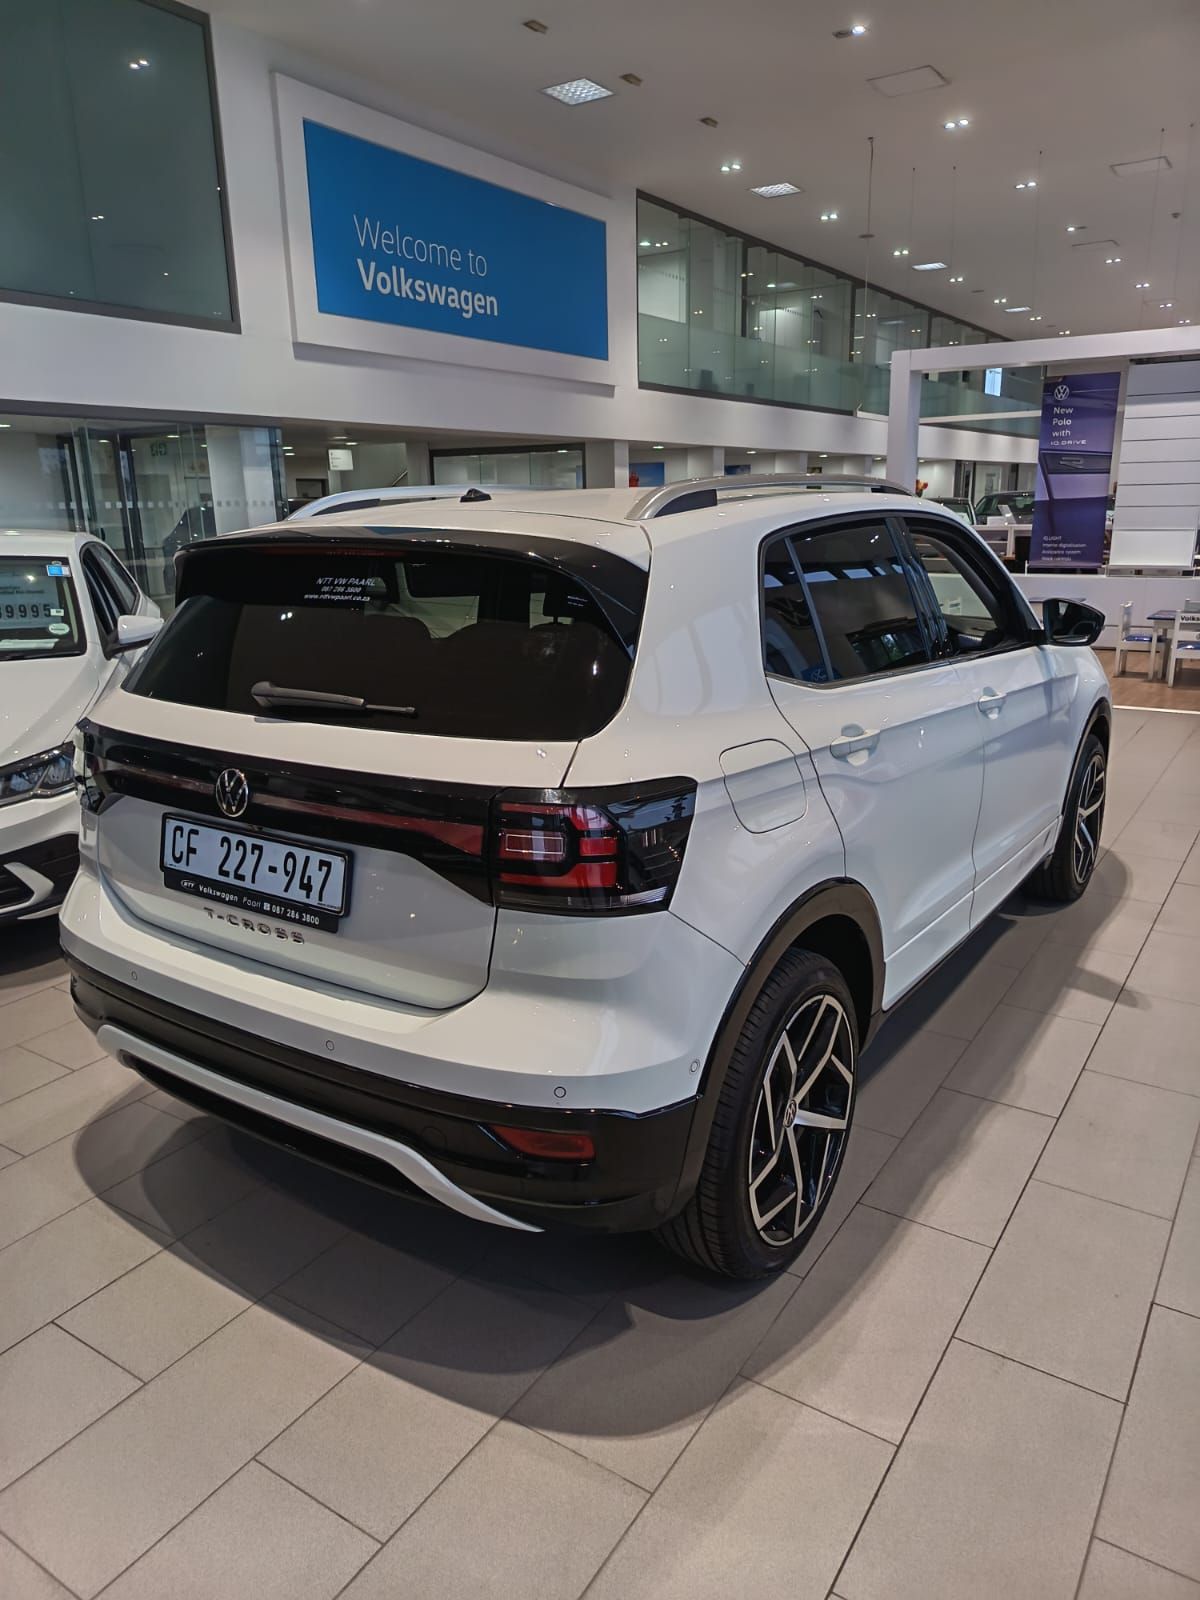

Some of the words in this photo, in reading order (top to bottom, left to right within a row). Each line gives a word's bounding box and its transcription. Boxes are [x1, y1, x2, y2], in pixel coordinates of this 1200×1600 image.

[353, 213, 462, 271] Welcome
[467, 249, 488, 277] to
[356, 258, 499, 319] Volkswagen
[1052, 418, 1072, 426] Polo
[1053, 407, 1074, 415] New
[1052, 429, 1071, 438] with
[316, 577, 333, 585] NTT
[333, 577, 348, 585] VW
[347, 577, 375, 586] PAARL
[0, 604, 51, 618] 9995
[171, 825, 200, 867] CF
[217, 836, 332, 902] 227-947
[199, 884, 239, 903] Volkswagen
[242, 896, 261, 909] Paarl
[271, 904, 284, 915] 087
[286, 908, 300, 920] 286
[302, 913, 320, 926] 3800
[203, 906, 305, 945] T-CROSS
